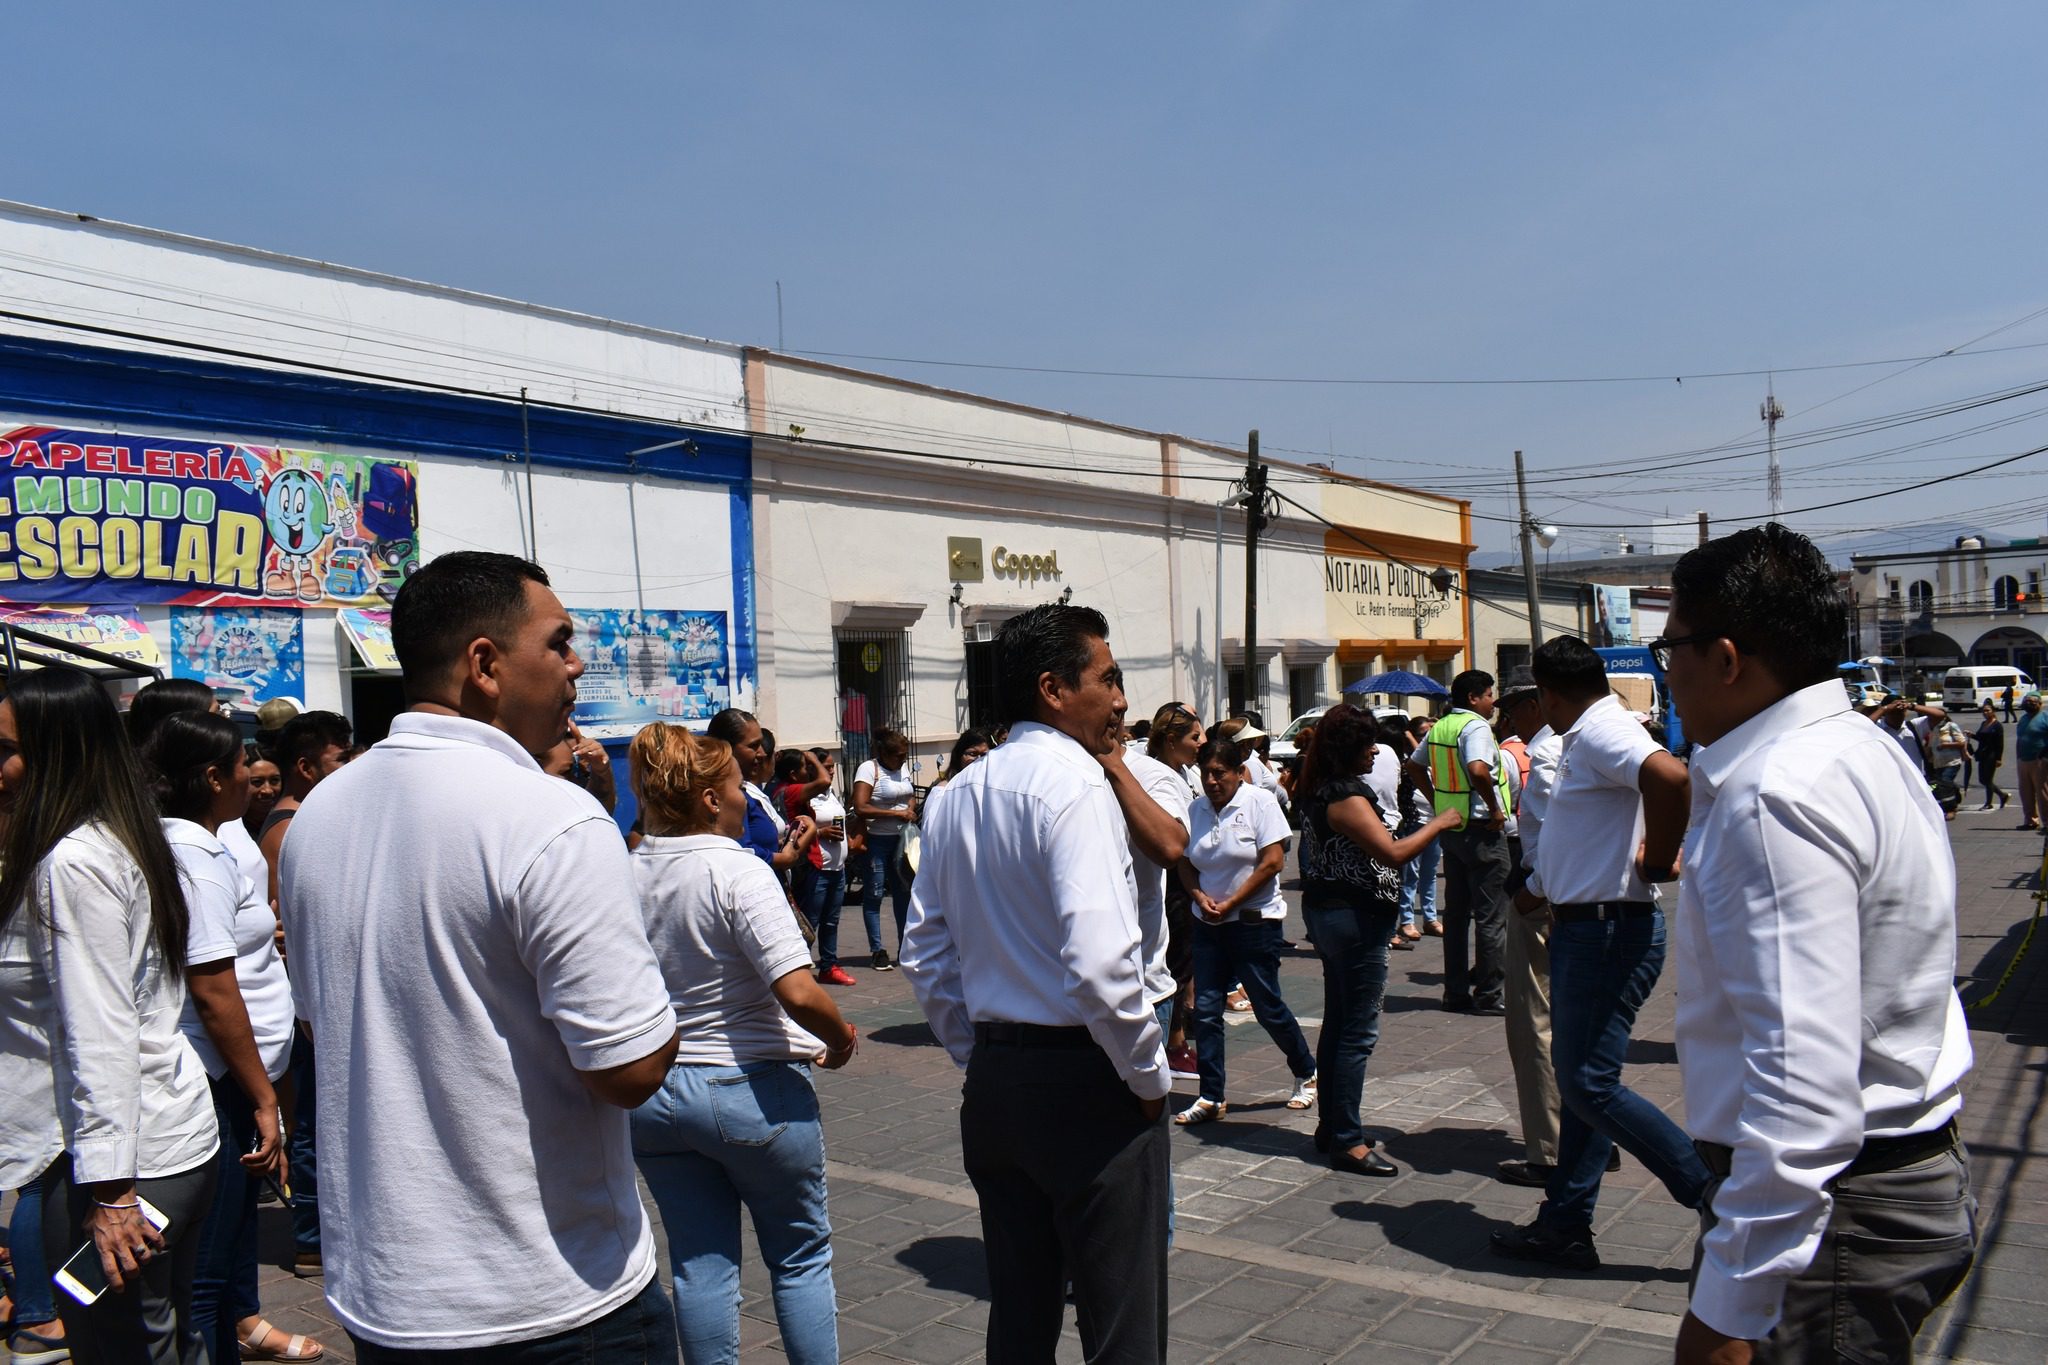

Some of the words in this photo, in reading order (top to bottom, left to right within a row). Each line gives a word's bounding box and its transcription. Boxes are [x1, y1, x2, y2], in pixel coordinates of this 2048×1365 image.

[14, 476, 216, 522] MUNDO
[991, 546, 1062, 581] Coppel
[1325, 556, 1381, 596] NOTARIA
[1356, 601, 1366, 616] Lic.
[1369, 602, 1386, 616] Pedro
[1611, 657, 1643, 669] pepsi
